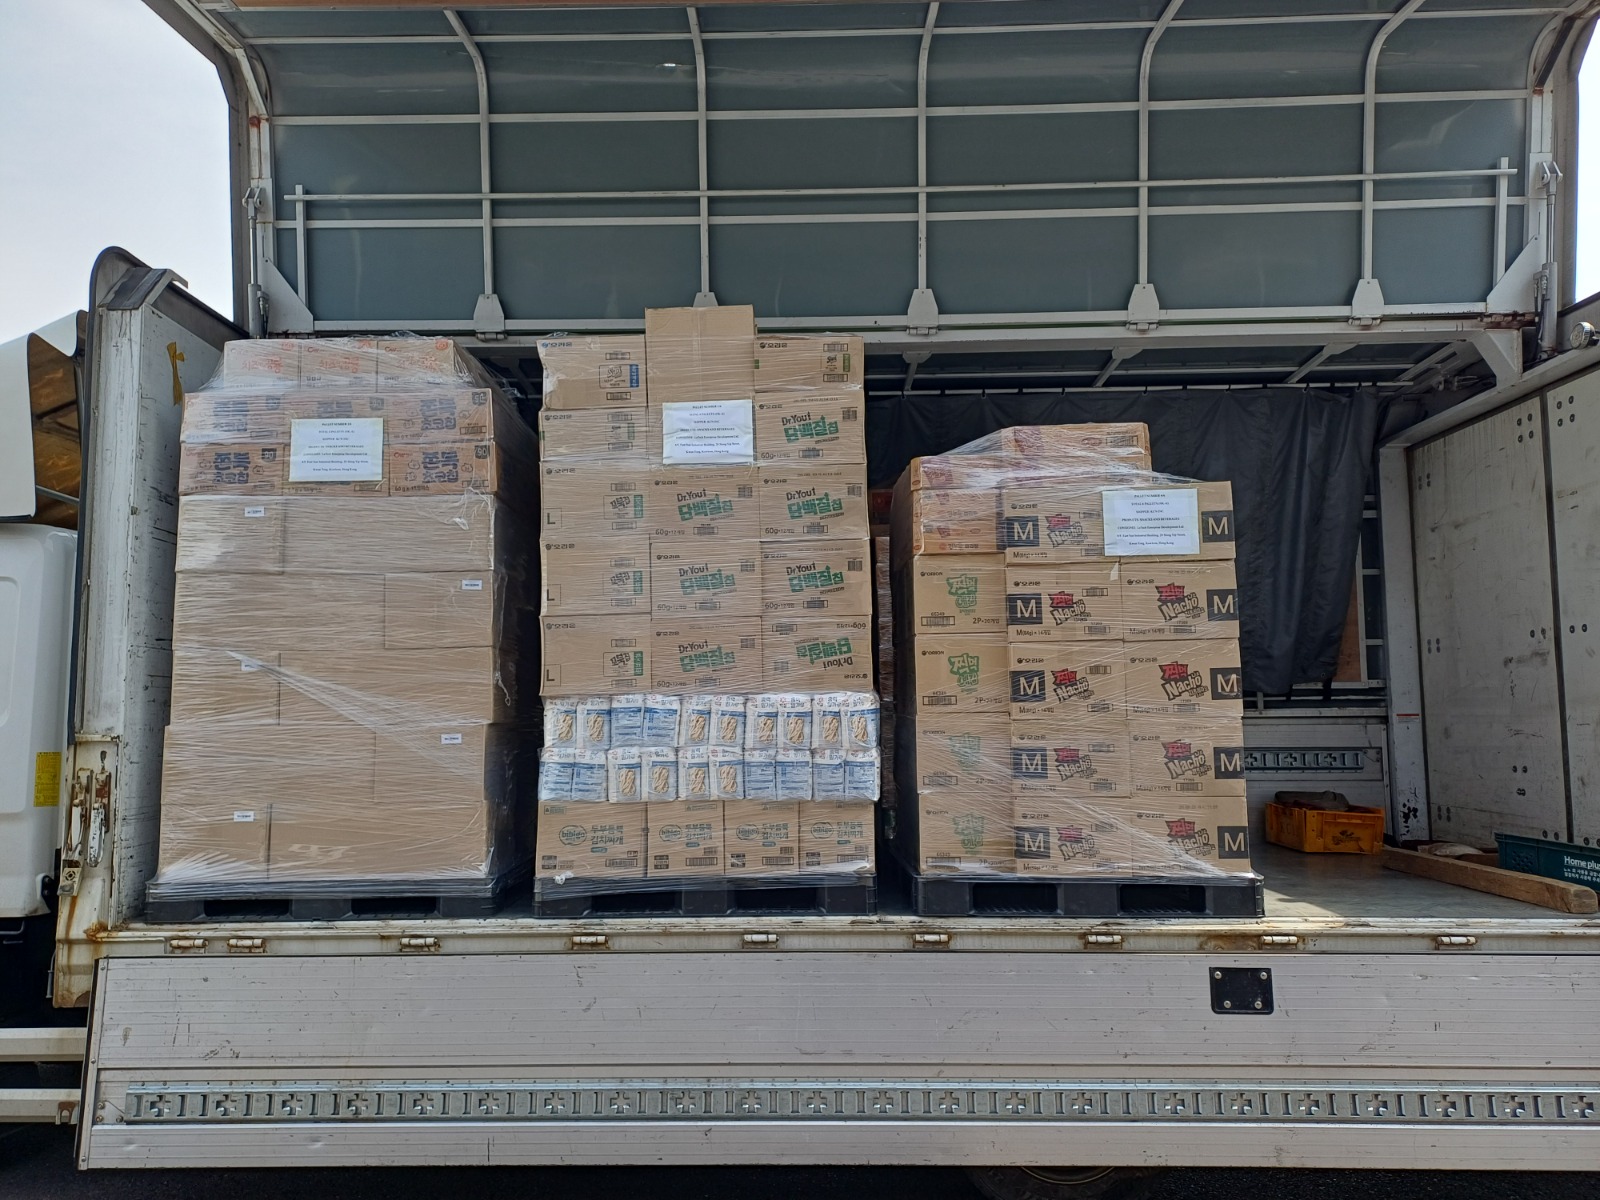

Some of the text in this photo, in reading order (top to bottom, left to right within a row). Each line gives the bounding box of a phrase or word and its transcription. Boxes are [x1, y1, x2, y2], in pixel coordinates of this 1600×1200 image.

[547, 513, 556, 525] L
[1208, 517, 1229, 536] M
[1013, 521, 1034, 541] M
[1049, 527, 1082, 548] Nacho
[546, 589, 555, 601] L
[1213, 594, 1234, 614] M
[1016, 599, 1037, 618] M
[1052, 602, 1086, 626] Nacho
[1160, 596, 1198, 622] Nacho
[546, 669, 555, 682] L
[1217, 673, 1238, 693] M
[1020, 676, 1040, 696] M
[1055, 680, 1089, 703] Nacho
[1162, 676, 1202, 701] Nacho
[1022, 753, 1042, 773] M
[1057, 759, 1092, 781] Nacho
[1166, 754, 1205, 779] Nacho
[1220, 752, 1240, 772] M
[1024, 832, 1044, 852] M
[1060, 839, 1094, 861] Nacho
[1224, 832, 1245, 852] M
[1564, 855, 1586, 867] Home
